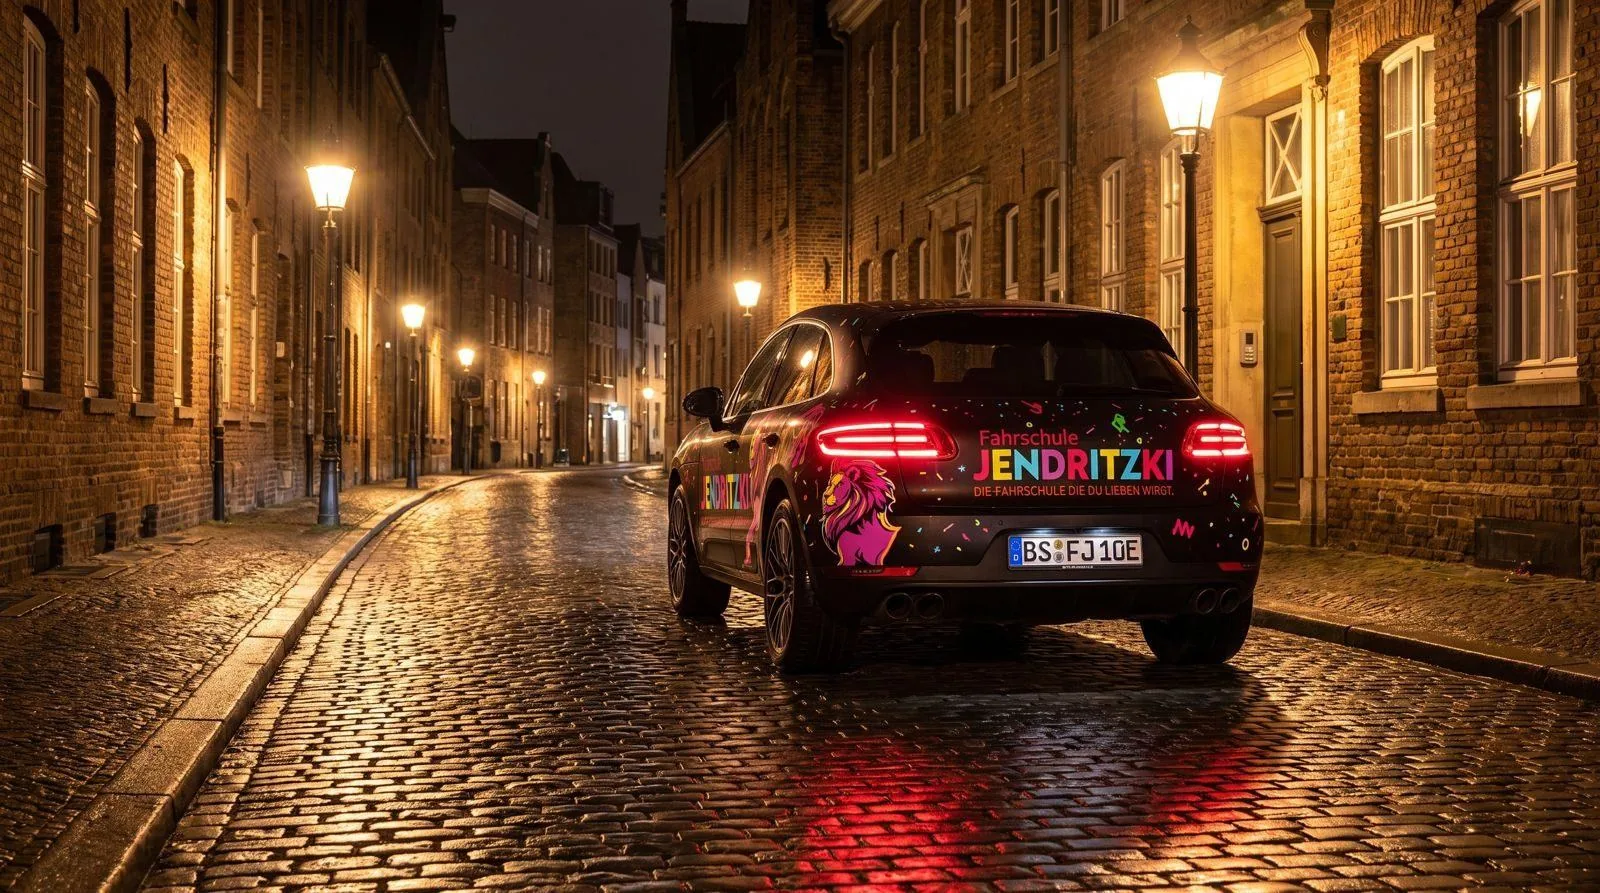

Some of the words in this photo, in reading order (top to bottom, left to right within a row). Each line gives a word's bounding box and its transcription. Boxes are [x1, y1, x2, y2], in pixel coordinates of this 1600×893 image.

[979, 428, 1078, 446] Fahrschule
[973, 448, 1173, 481] JENDRITZKI
[700, 473, 750, 510] JENDRITZKI
[1068, 485, 1085, 496] DIE
[1087, 485, 1103, 496] DU
[1105, 485, 1140, 496] LIEBEN
[1141, 485, 1175, 496] WIRGT.
[1023, 541, 1052, 562] BS
